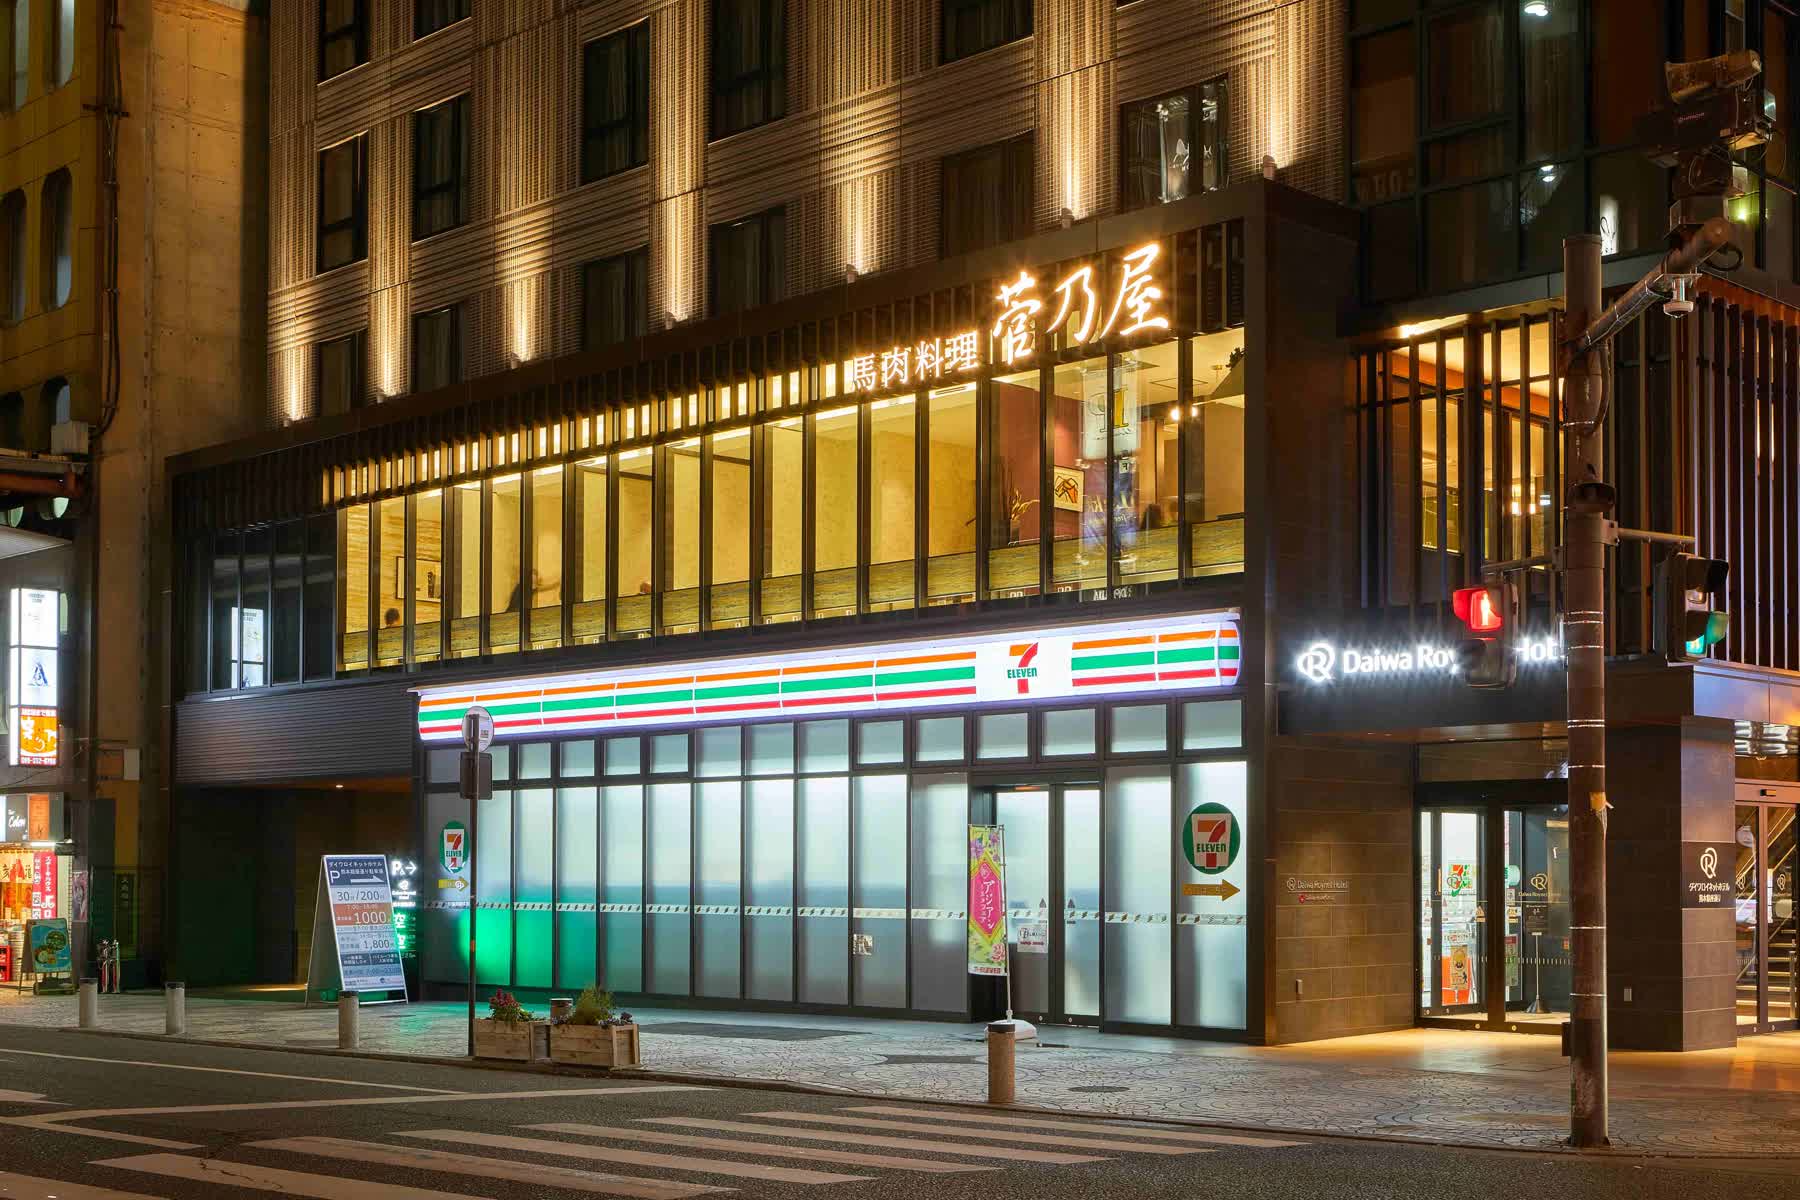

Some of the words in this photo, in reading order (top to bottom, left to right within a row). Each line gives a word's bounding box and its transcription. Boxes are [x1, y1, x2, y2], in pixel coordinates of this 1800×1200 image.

[993, 242, 1170, 365] 菅乃屋
[851, 330, 980, 391] 馬肉料理
[1342, 649, 1413, 674] Daiwa
[1416, 644, 1459, 675] Roy
[1512, 637, 1560, 661] Hot
[329, 870, 341, 884] P
[1688, 882, 1731, 892] ダイワロイネットホテル
